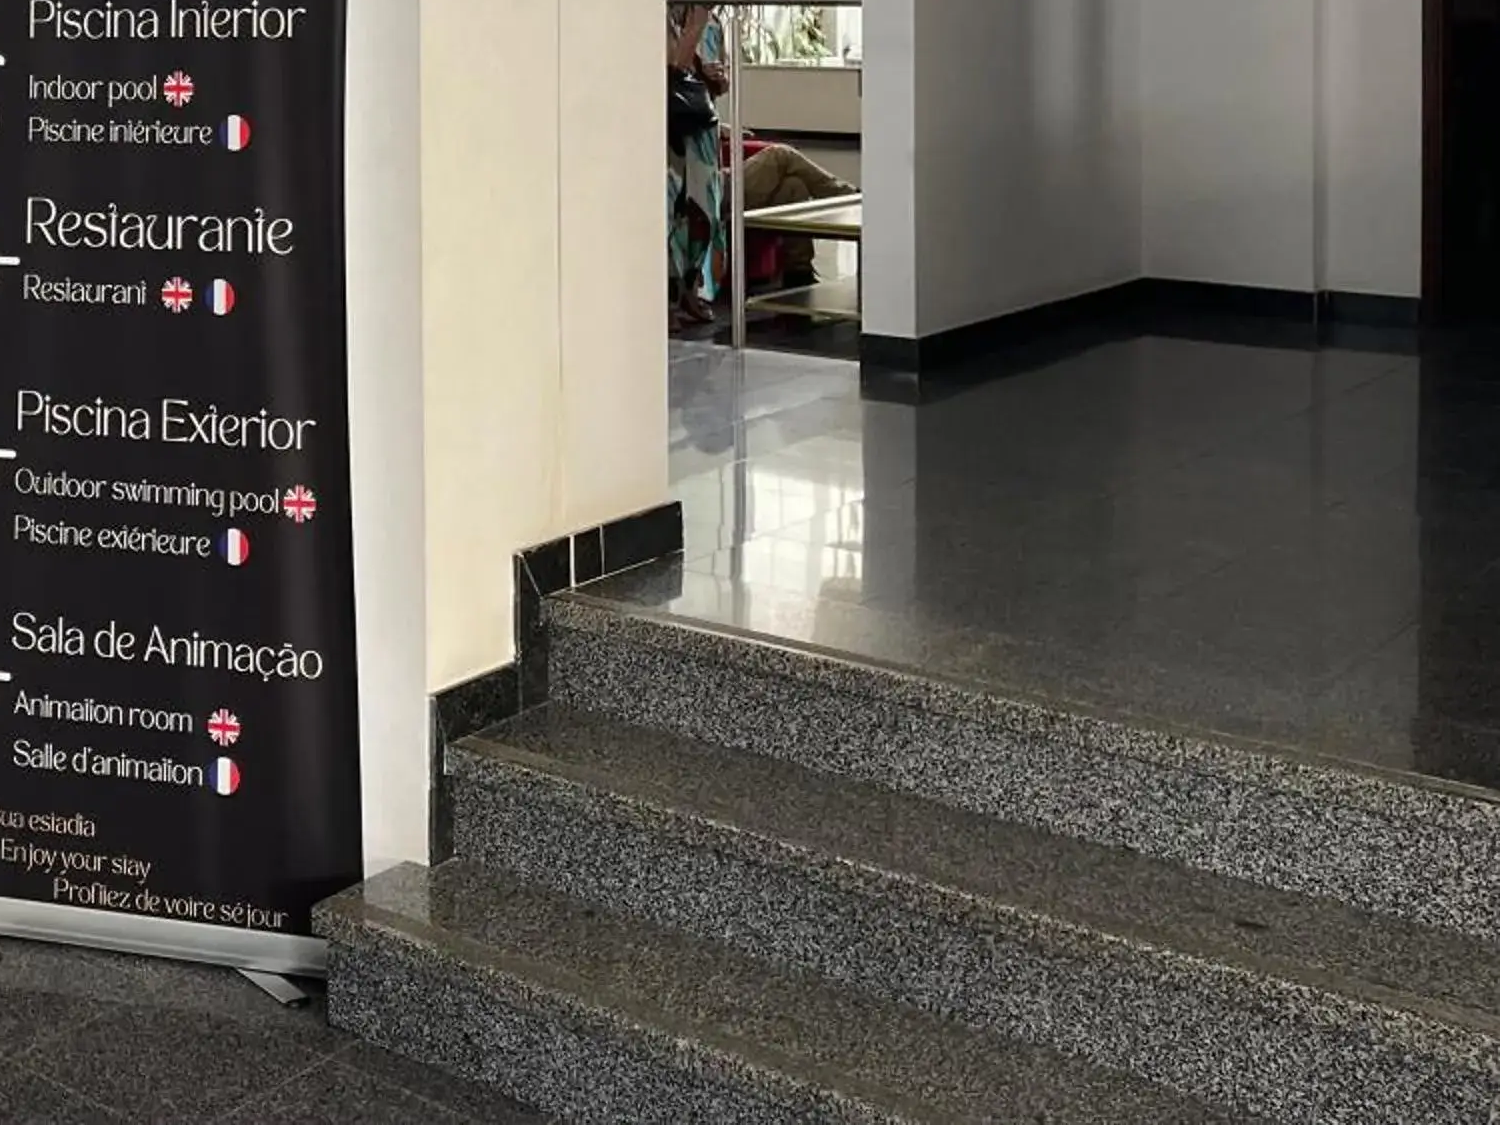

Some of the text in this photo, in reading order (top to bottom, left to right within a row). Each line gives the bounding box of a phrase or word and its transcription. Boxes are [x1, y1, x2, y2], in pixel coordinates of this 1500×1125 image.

[30, 0, 158, 39] Piscina
[30, 75, 156, 107] Indoor pool
[29, 117, 212, 145] Piscine intérieure
[27, 197, 293, 255] Restaurante
[24, 275, 146, 305] Restaurant
[18, 390, 316, 450] Piscina Exterior
[15, 467, 279, 517] Outdoor swimming pool
[14, 515, 210, 557] Piscine extérieure
[12, 612, 323, 682] Sala de Animação
[14, 690, 192, 732] Animation room
[14, 740, 203, 786] Salle d'animation
[28, 813, 95, 837] estadia
[1, 838, 150, 884] Enjoy your stay
[53, 878, 288, 931] Profitez de votre séjour
